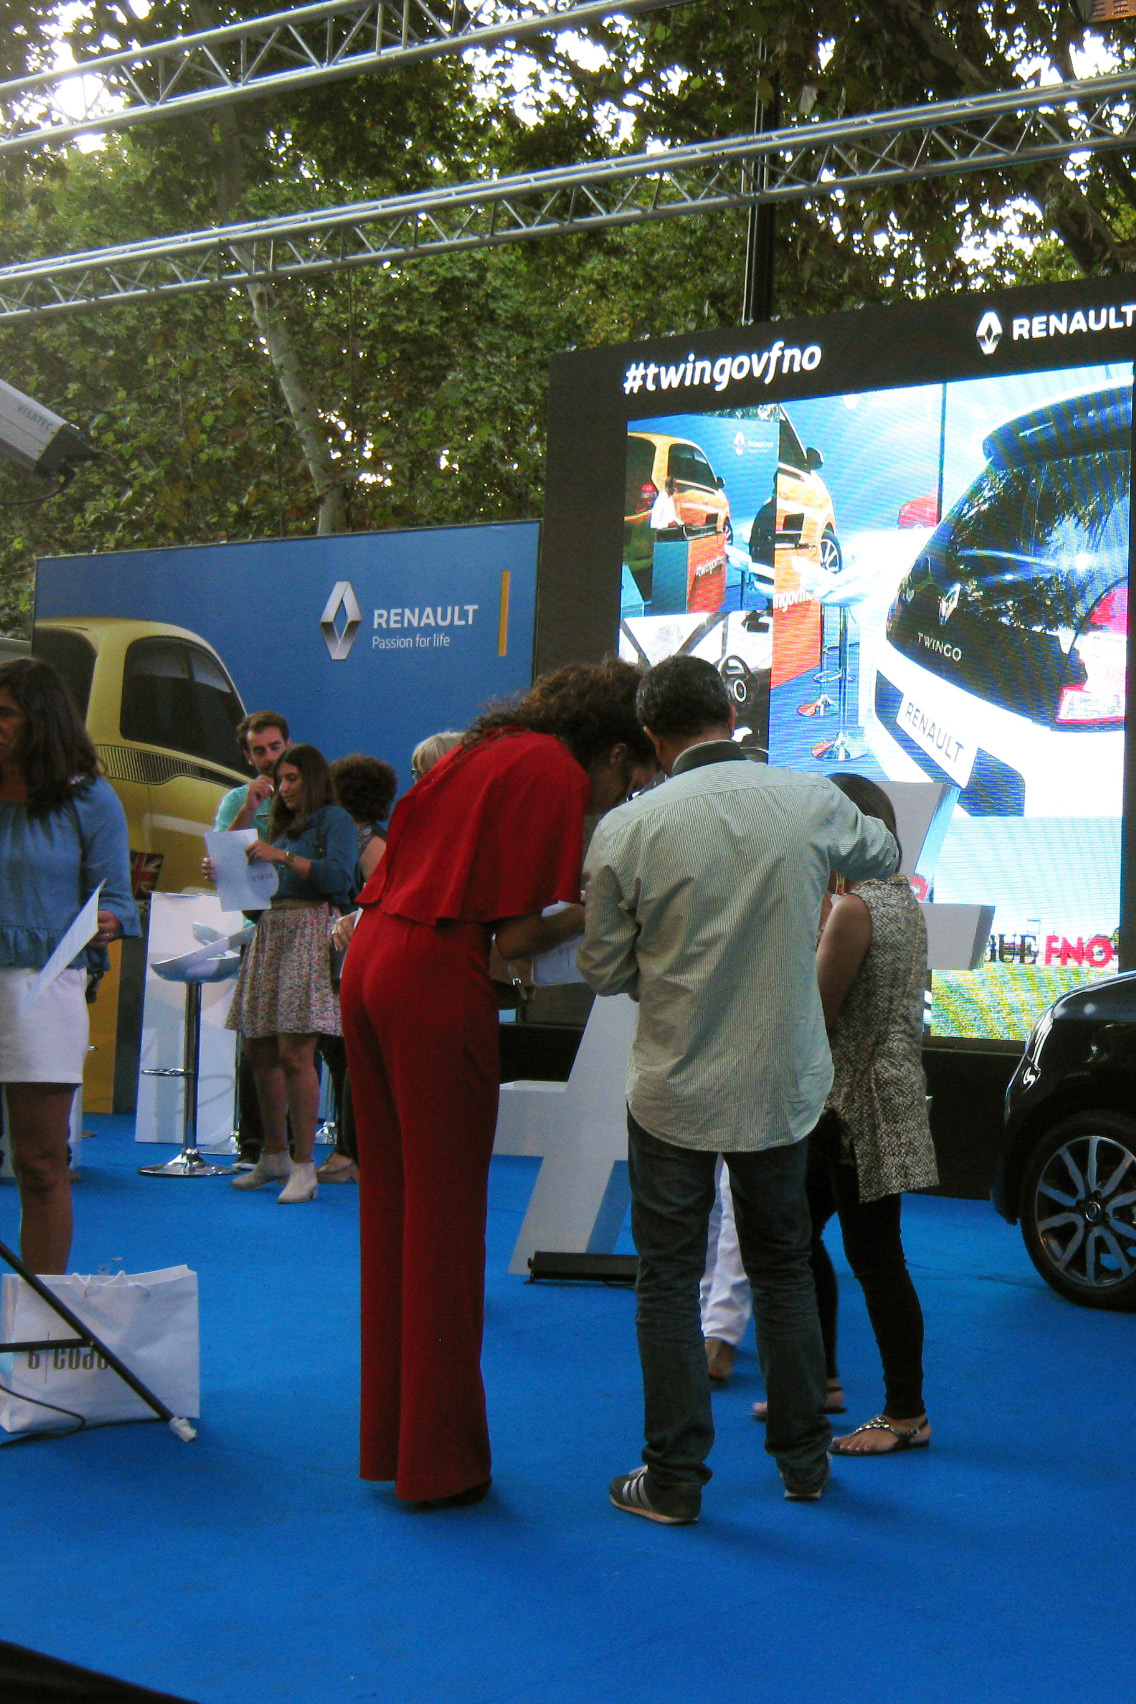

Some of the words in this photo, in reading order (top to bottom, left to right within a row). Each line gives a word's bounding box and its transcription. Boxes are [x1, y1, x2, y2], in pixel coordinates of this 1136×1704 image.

[623, 341, 821, 394] #twingovfno
[373, 605, 478, 628] RENAULT
[372, 636, 413, 649] Passion
[416, 634, 431, 647] for
[433, 633, 451, 647] life
[917, 632, 963, 662] TWINGO
[905, 701, 965, 764] RENAULT
[1045, 935, 1114, 967] FNO
